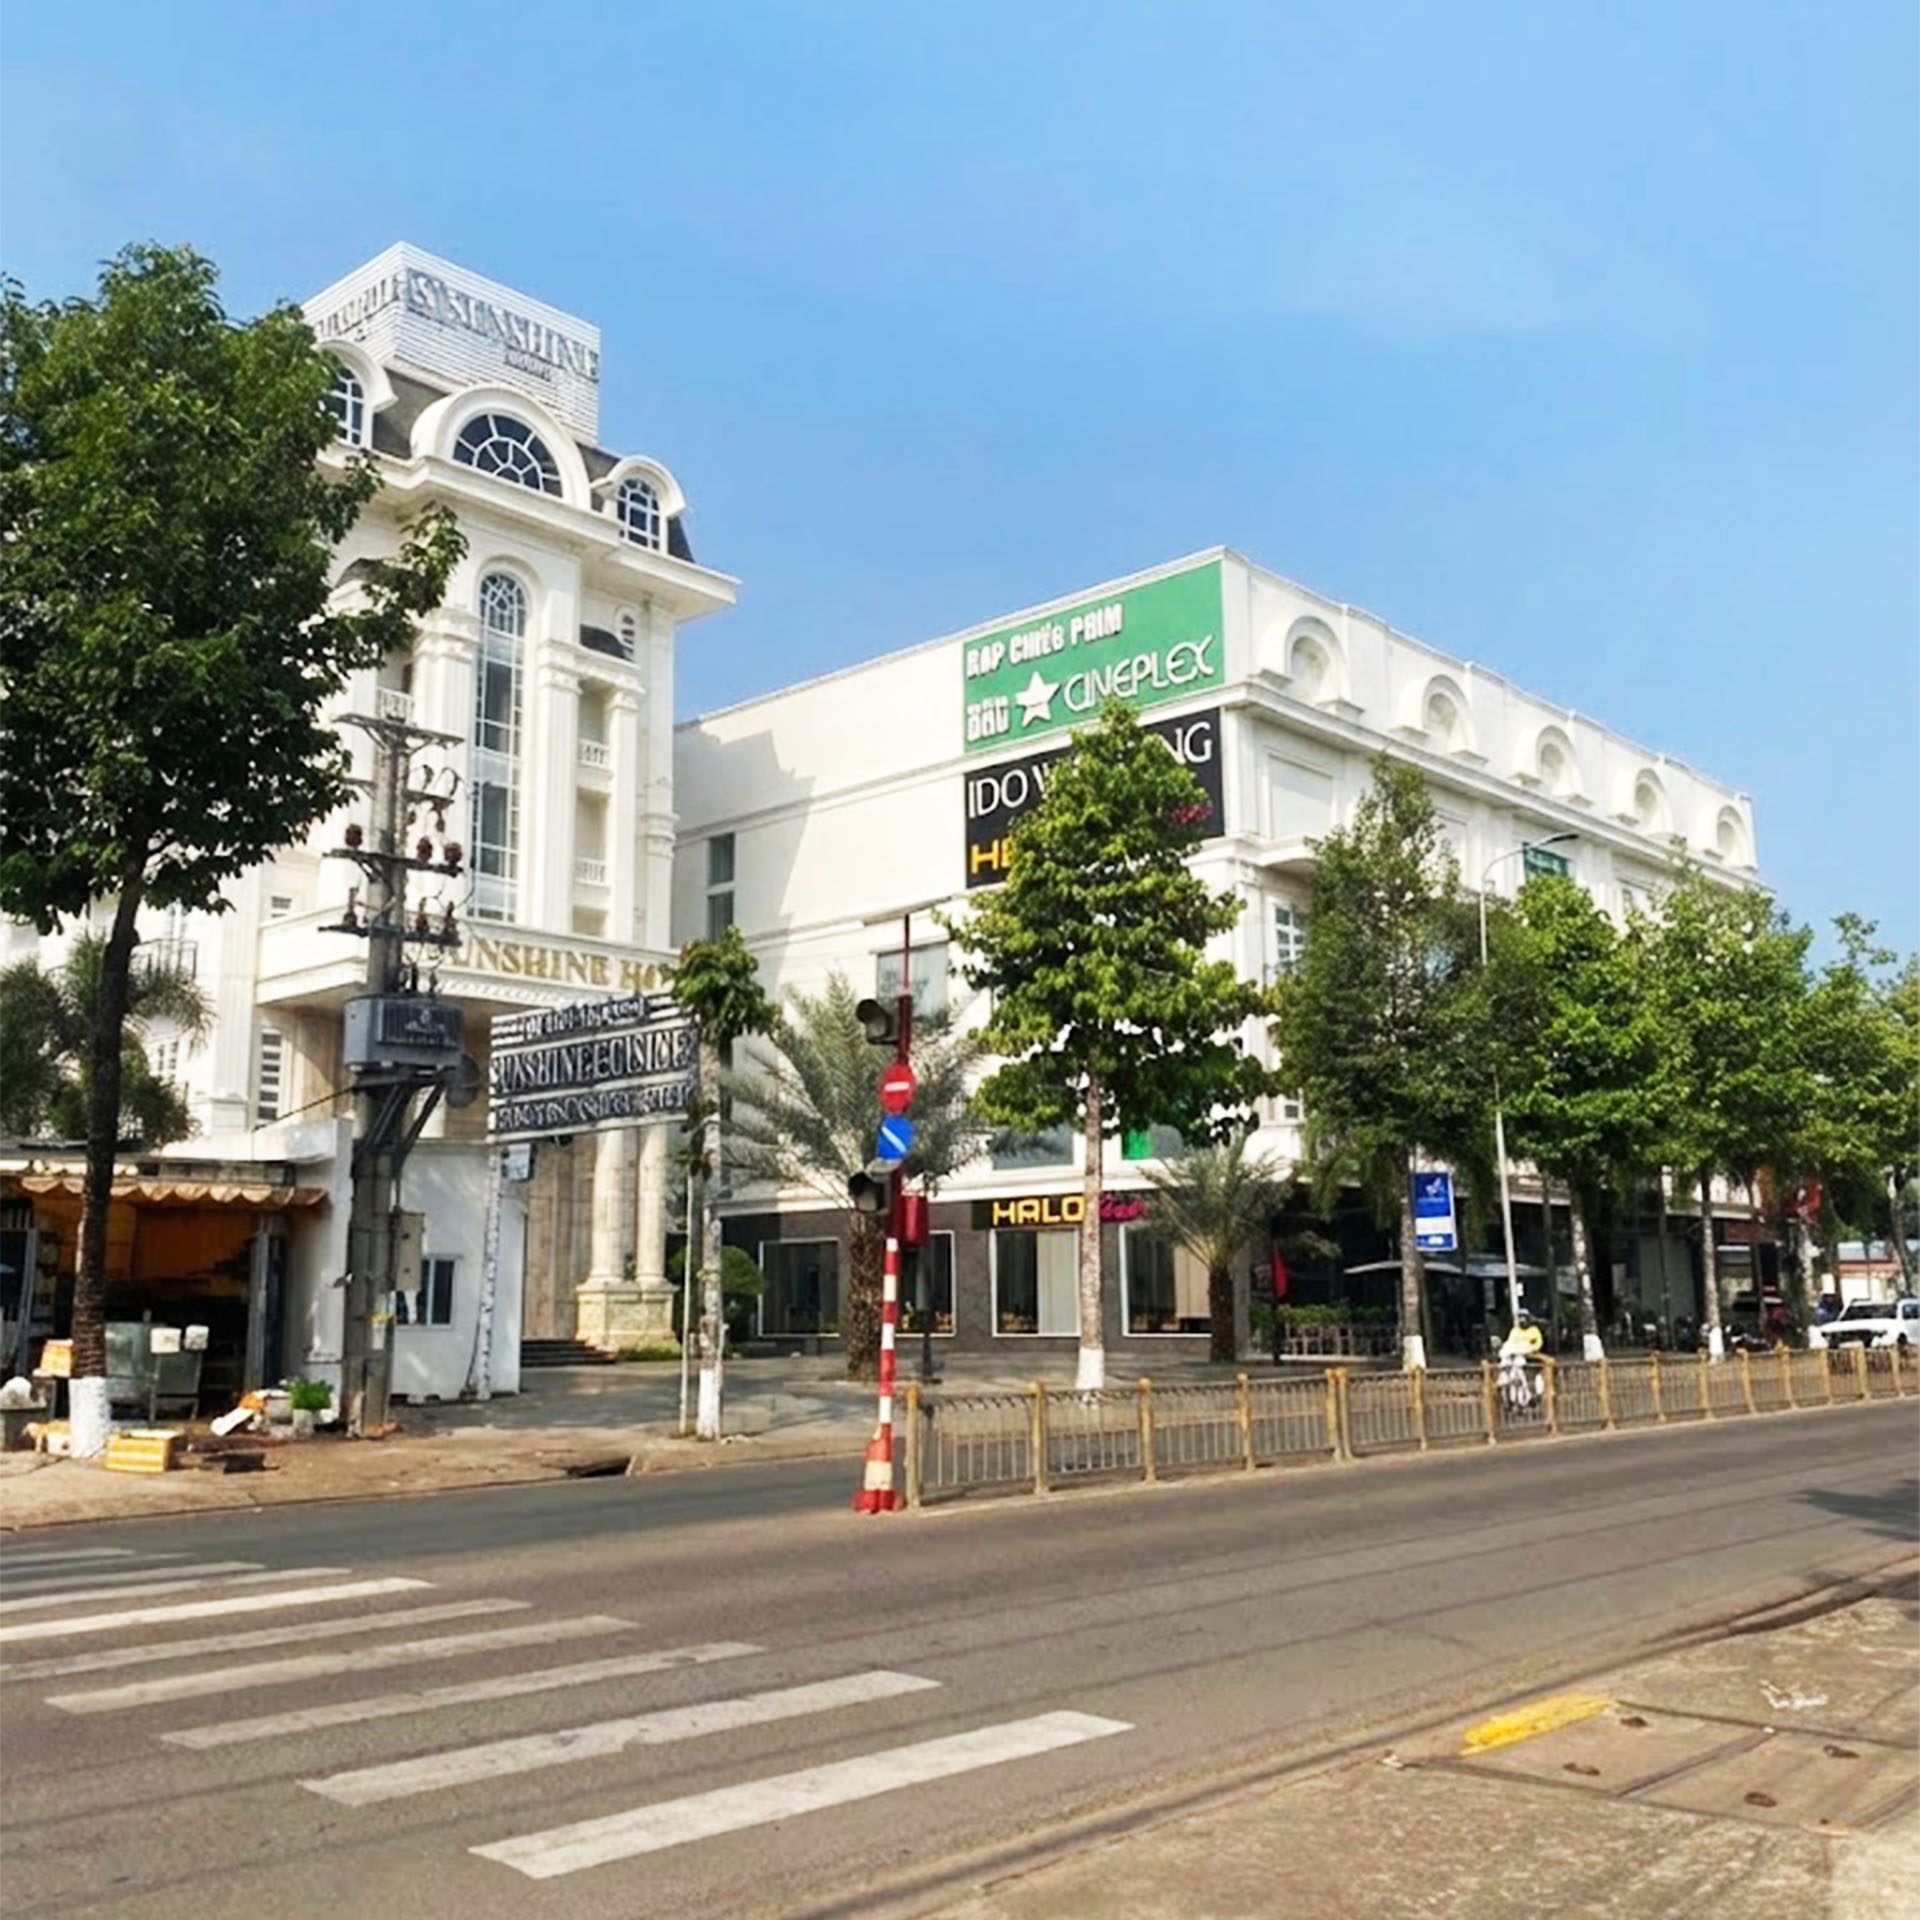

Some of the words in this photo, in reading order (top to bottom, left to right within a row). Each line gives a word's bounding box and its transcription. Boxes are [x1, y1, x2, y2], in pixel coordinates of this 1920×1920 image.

[1064, 634, 1214, 711] CINEPLEX
[450, 933, 610, 986] UNSHINE
[993, 1196, 1086, 1225] HALO
